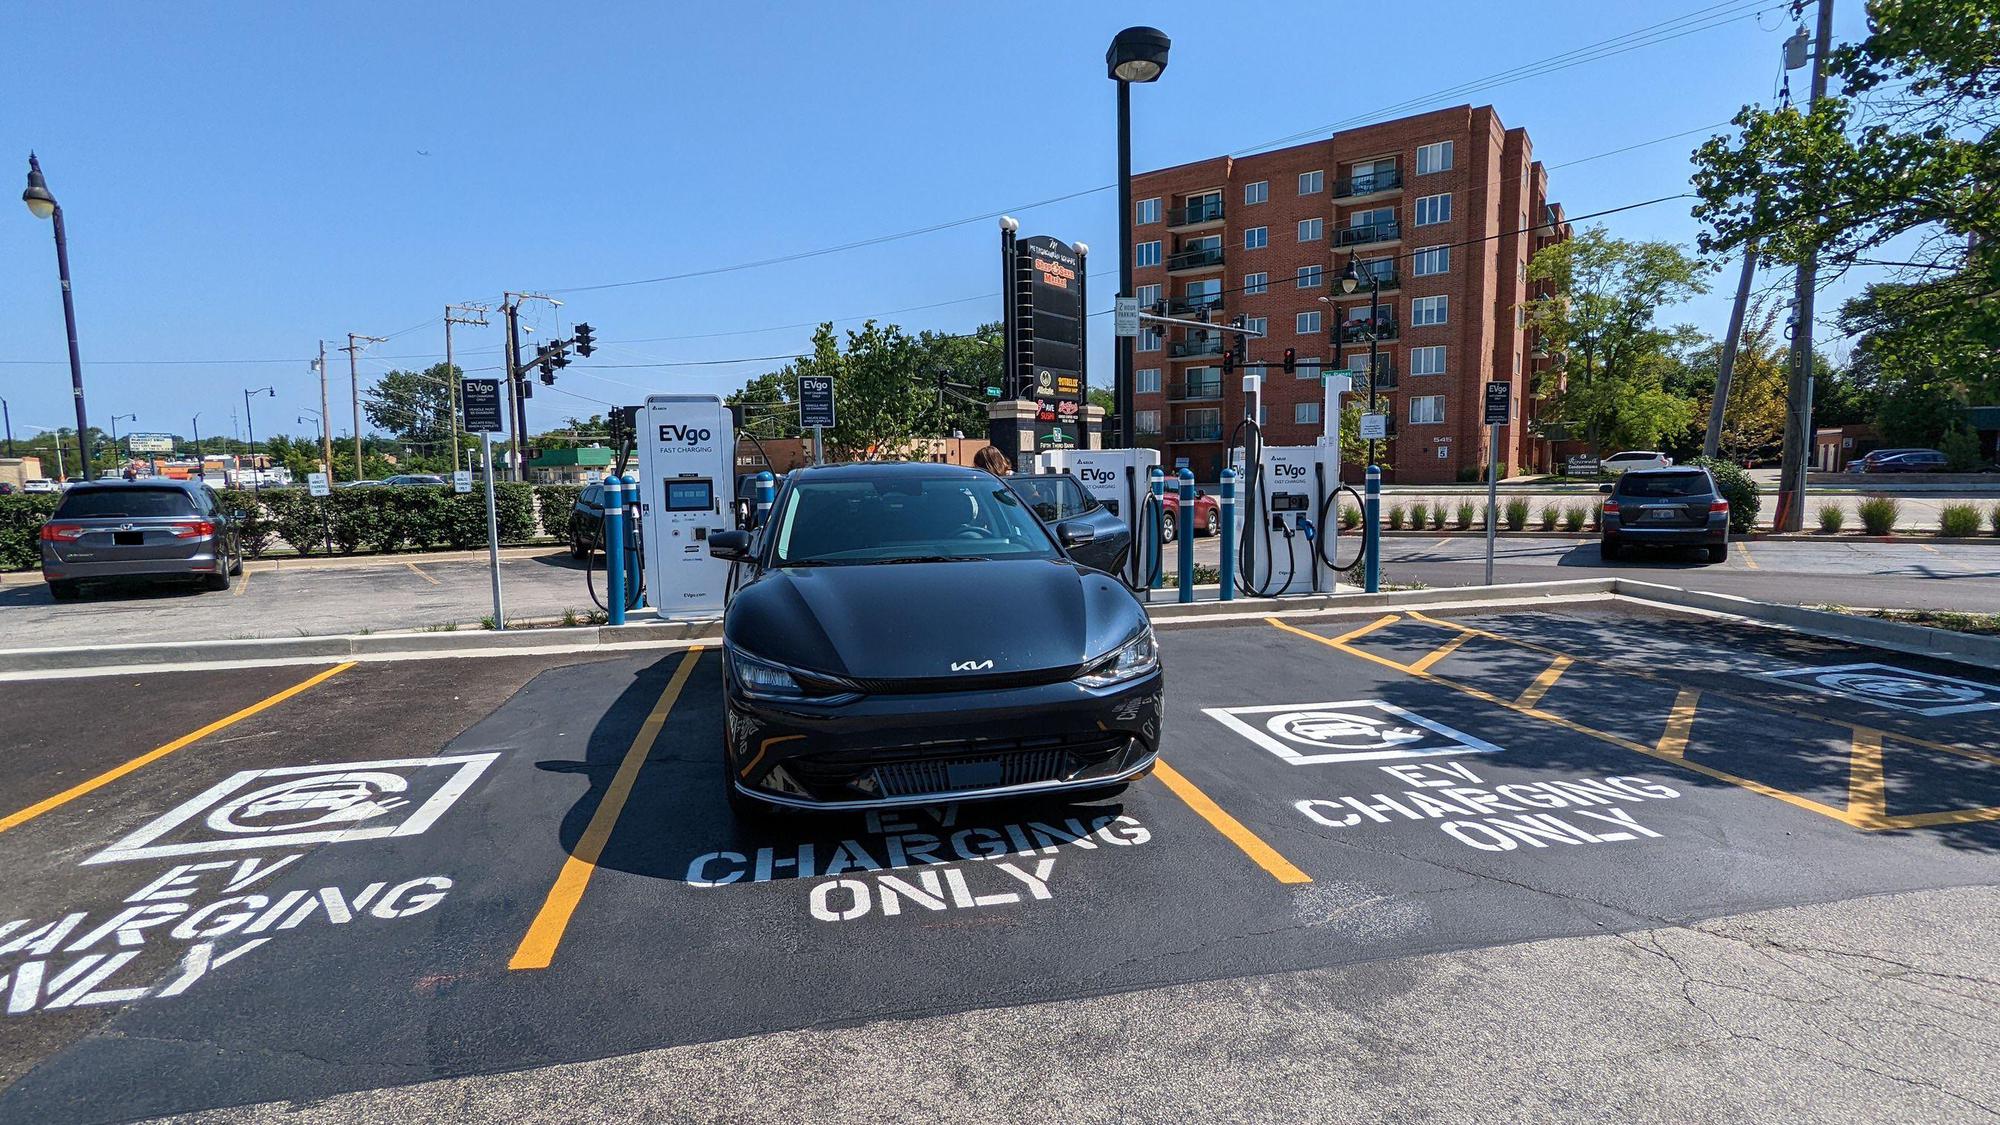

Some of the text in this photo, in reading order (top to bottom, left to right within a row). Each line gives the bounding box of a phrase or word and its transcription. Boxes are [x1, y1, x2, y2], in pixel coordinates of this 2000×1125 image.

[1035, 259, 1052, 272] Shop
[1044, 273, 1067, 288] Market
[466, 382, 494, 394] EVgo
[804, 381, 828, 391] EVgo
[1489, 385, 1507, 394] EVgo
[1046, 404, 1055, 412] AVE
[659, 425, 711, 446] EVgo
[1081, 468, 1115, 484] EVgo
[1275, 464, 1306, 478] EVgo
[1379, 762, 1485, 788] EV
[1294, 776, 1681, 827] CHARGING
[865, 802, 959, 834] EV
[1440, 807, 1664, 852] ONLY
[686, 815, 1152, 887] CHARGING
[123, 854, 303, 902] EV
[810, 858, 1056, 921] ONLY
[0, 876, 452, 955] ARGING
[0, 937, 272, 1014] NLY
